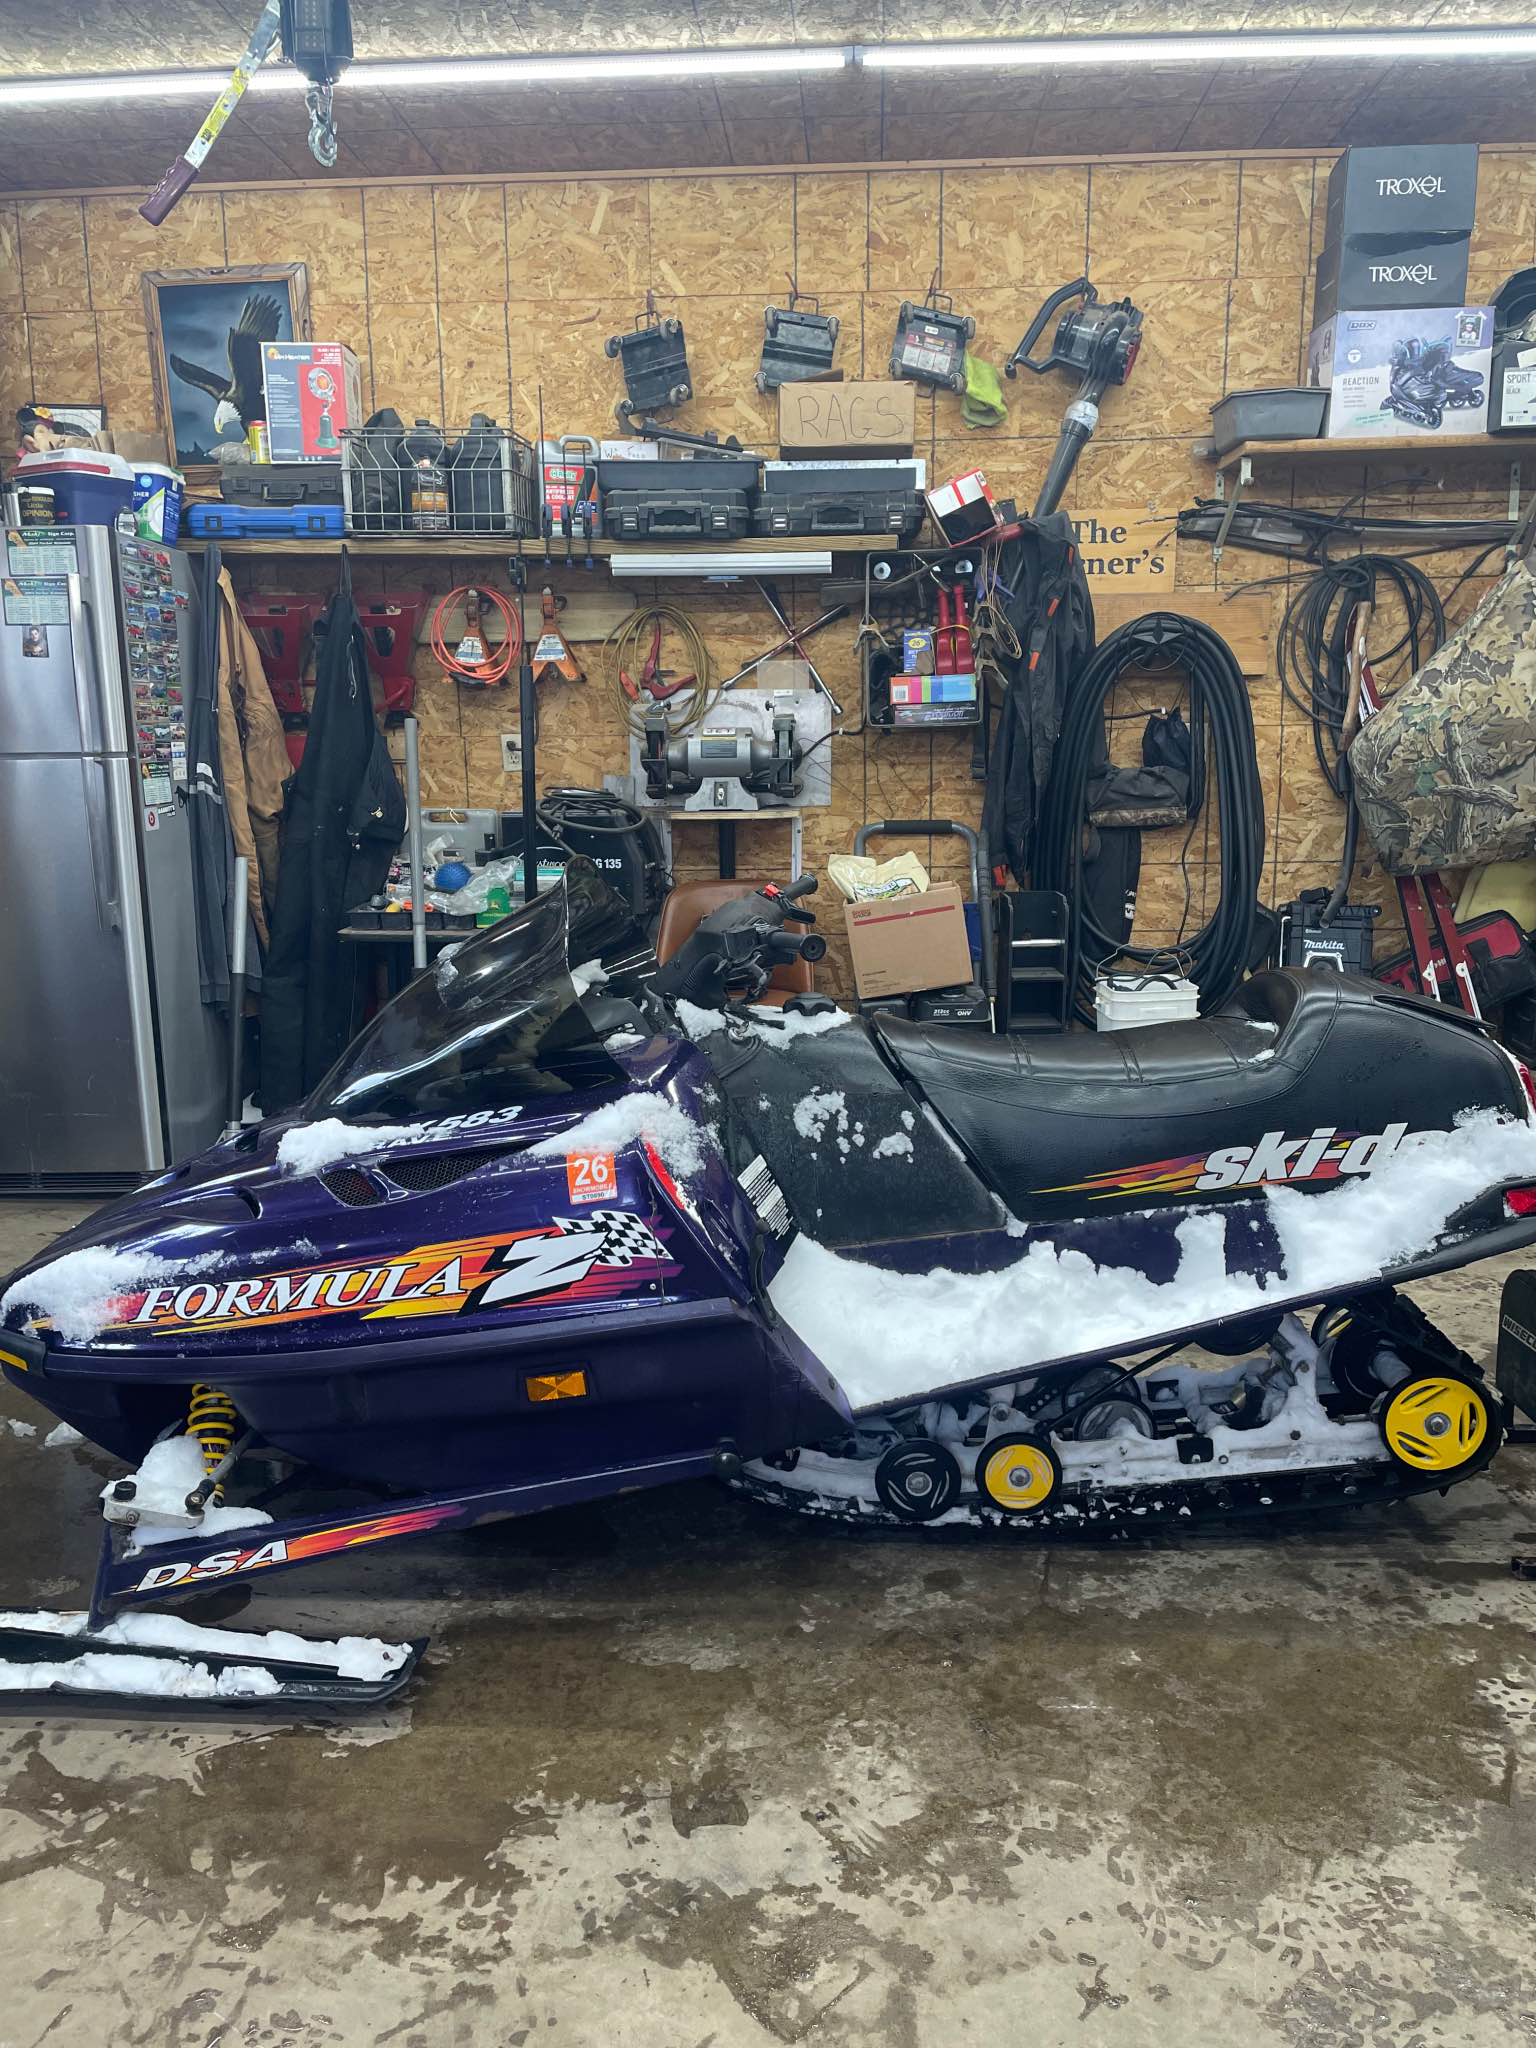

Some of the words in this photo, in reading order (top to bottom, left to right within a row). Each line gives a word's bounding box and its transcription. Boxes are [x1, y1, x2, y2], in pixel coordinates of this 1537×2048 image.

[1376, 175, 1446, 196] TROXEL
[1369, 264, 1437, 285] TROXEL
[1342, 376, 1380, 386] REACTION
[1507, 373, 1531, 384] SPORT
[797, 394, 905, 440] RAGS
[1071, 519, 1127, 544] The
[1082, 549, 1165, 575] ner's
[604, 858, 622, 869] 135
[1303, 939, 1345, 950] Makita
[1195, 1122, 1458, 1191] ski-d
[573, 1155, 608, 1186] 26
[129, 1256, 466, 1324] FORMULA
[478, 1228, 612, 1305] Z
[136, 1540, 290, 1593] DSA
